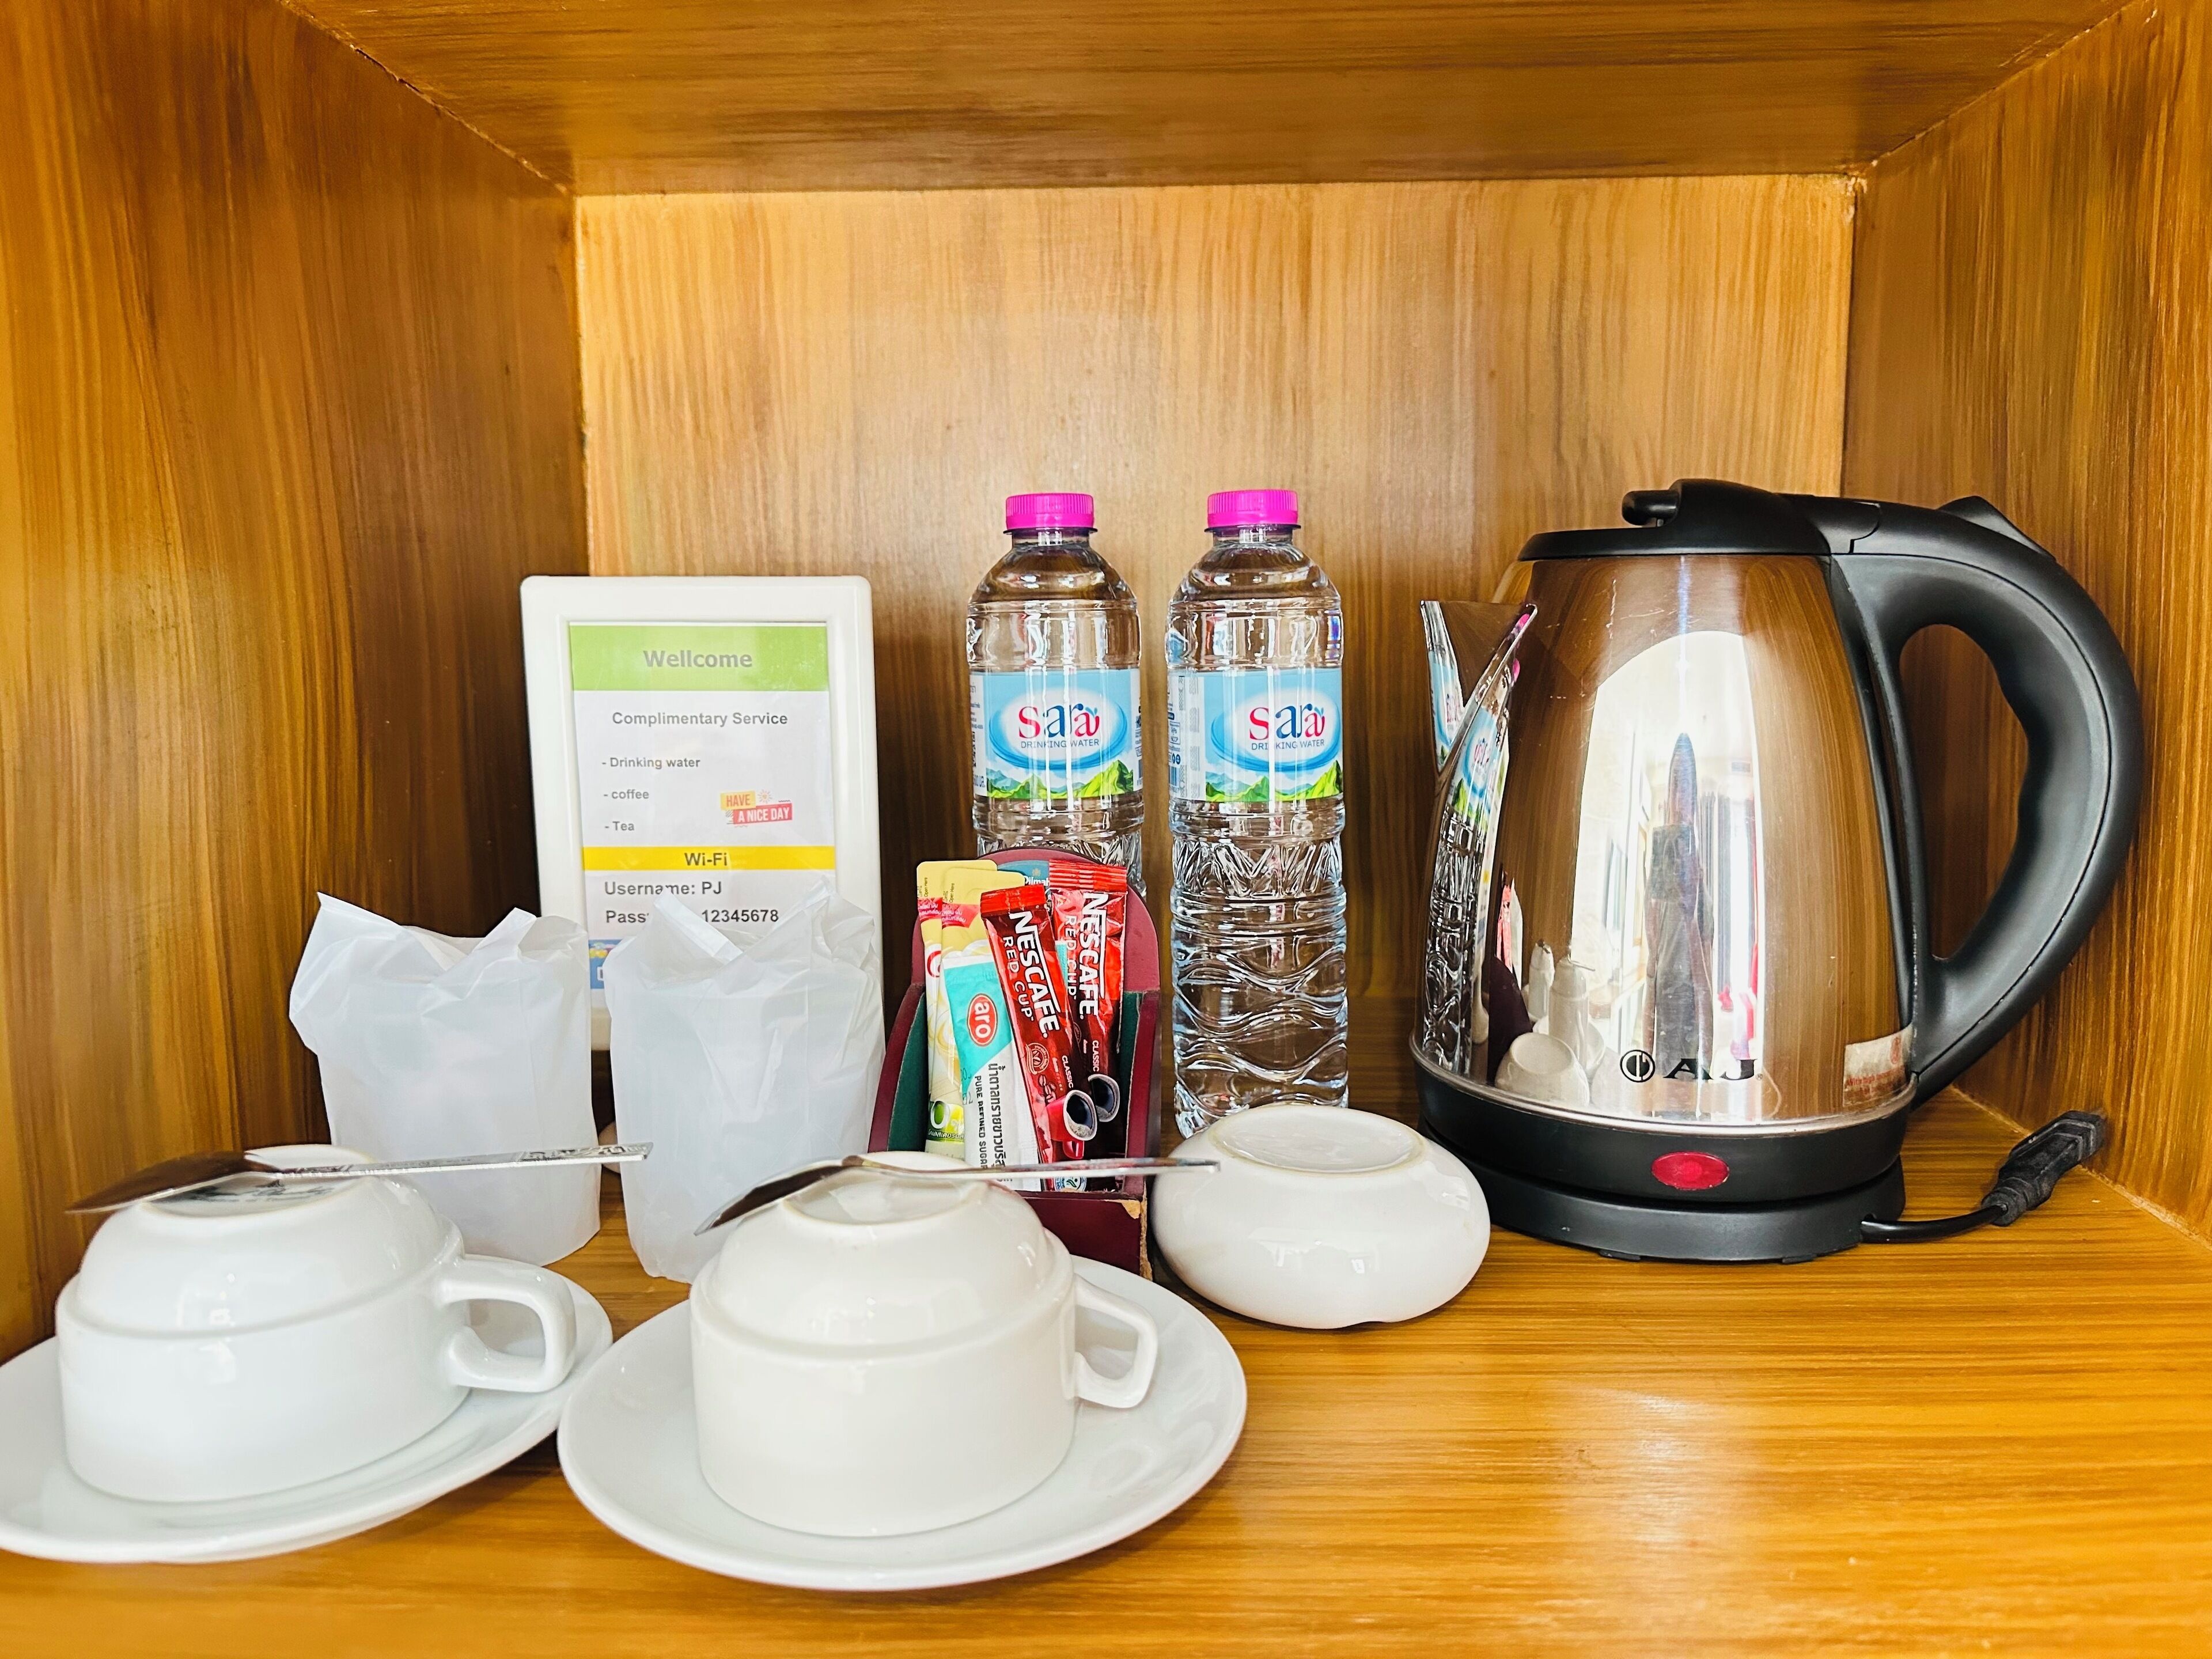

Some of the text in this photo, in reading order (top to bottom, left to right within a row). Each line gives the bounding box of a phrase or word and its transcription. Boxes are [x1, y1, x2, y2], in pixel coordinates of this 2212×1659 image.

[643, 649, 752, 668] Wellcome
[612, 711, 788, 728] Complimentary Service
[1070, 738, 1099, 748] WATER
[1251, 739, 1325, 750] DRIKING WATER
[609, 756, 700, 770] Drinking water
[611, 789, 650, 800] coffee
[726, 794, 751, 807] HAVE
[738, 806, 790, 823] A NICE DAY
[612, 820, 635, 832] Tea
[684, 852, 728, 866] Wi-Fi
[701, 881, 722, 895] PJ
[701, 909, 779, 923] 12345678
[1065, 915, 1077, 950] RED
[1003, 936, 1020, 973] RED
[973, 1003, 991, 1039] aro
[1062, 1055, 1074, 1088] CLASSIC
[1662, 1058, 1758, 1081] AJ
[974, 1075, 983, 1099] PURE
[978, 1101, 986, 1138] REFINED
